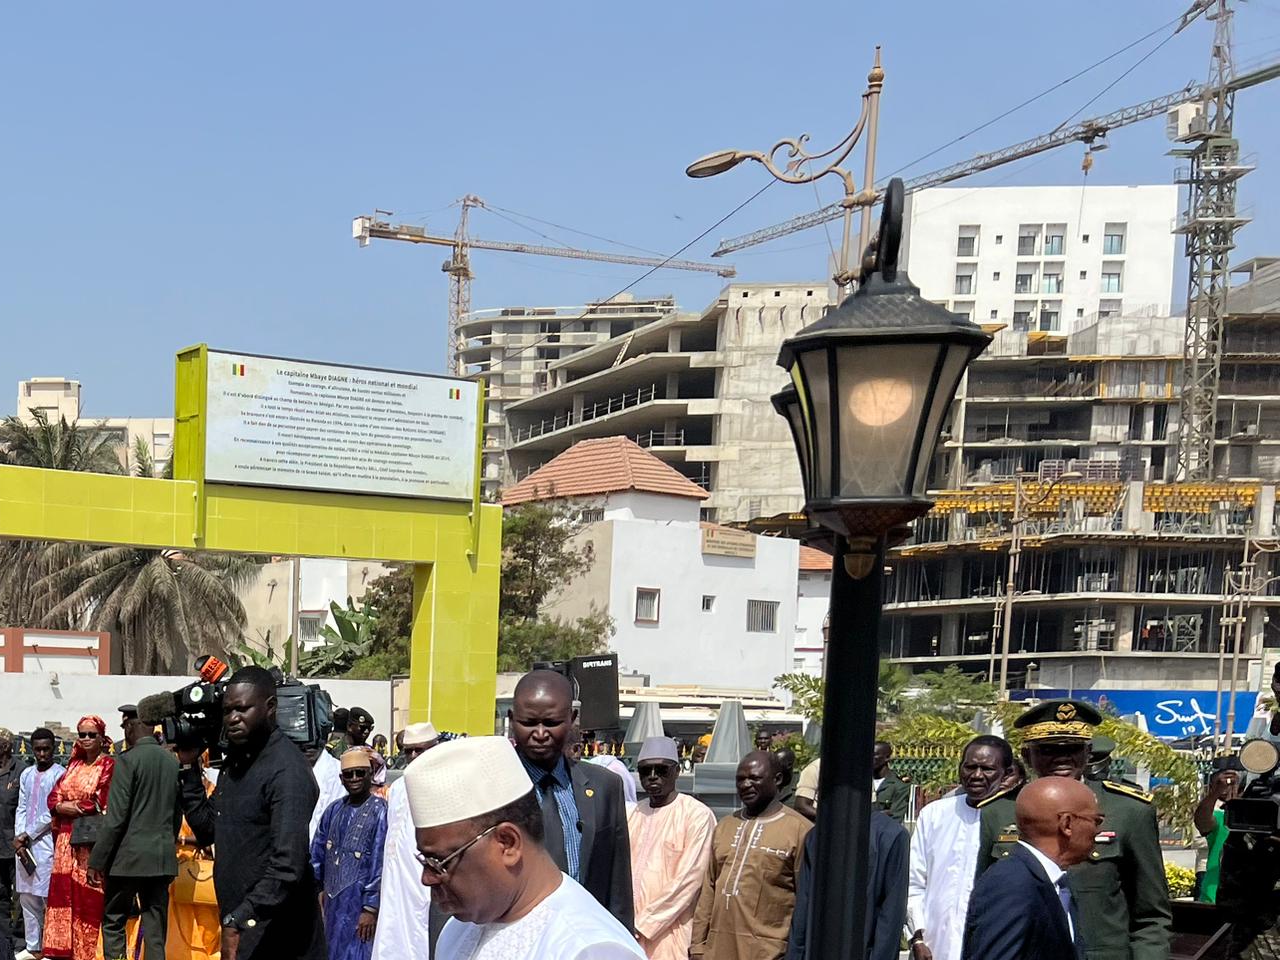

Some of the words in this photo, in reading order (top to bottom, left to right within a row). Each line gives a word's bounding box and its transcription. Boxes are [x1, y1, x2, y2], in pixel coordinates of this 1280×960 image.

[283, 369, 309, 379] capitaine
[310, 372, 327, 381] Mbaye
[328, 374, 348, 382] DIAGNE
[368, 379, 389, 387] national
[397, 382, 417, 390] mondial
